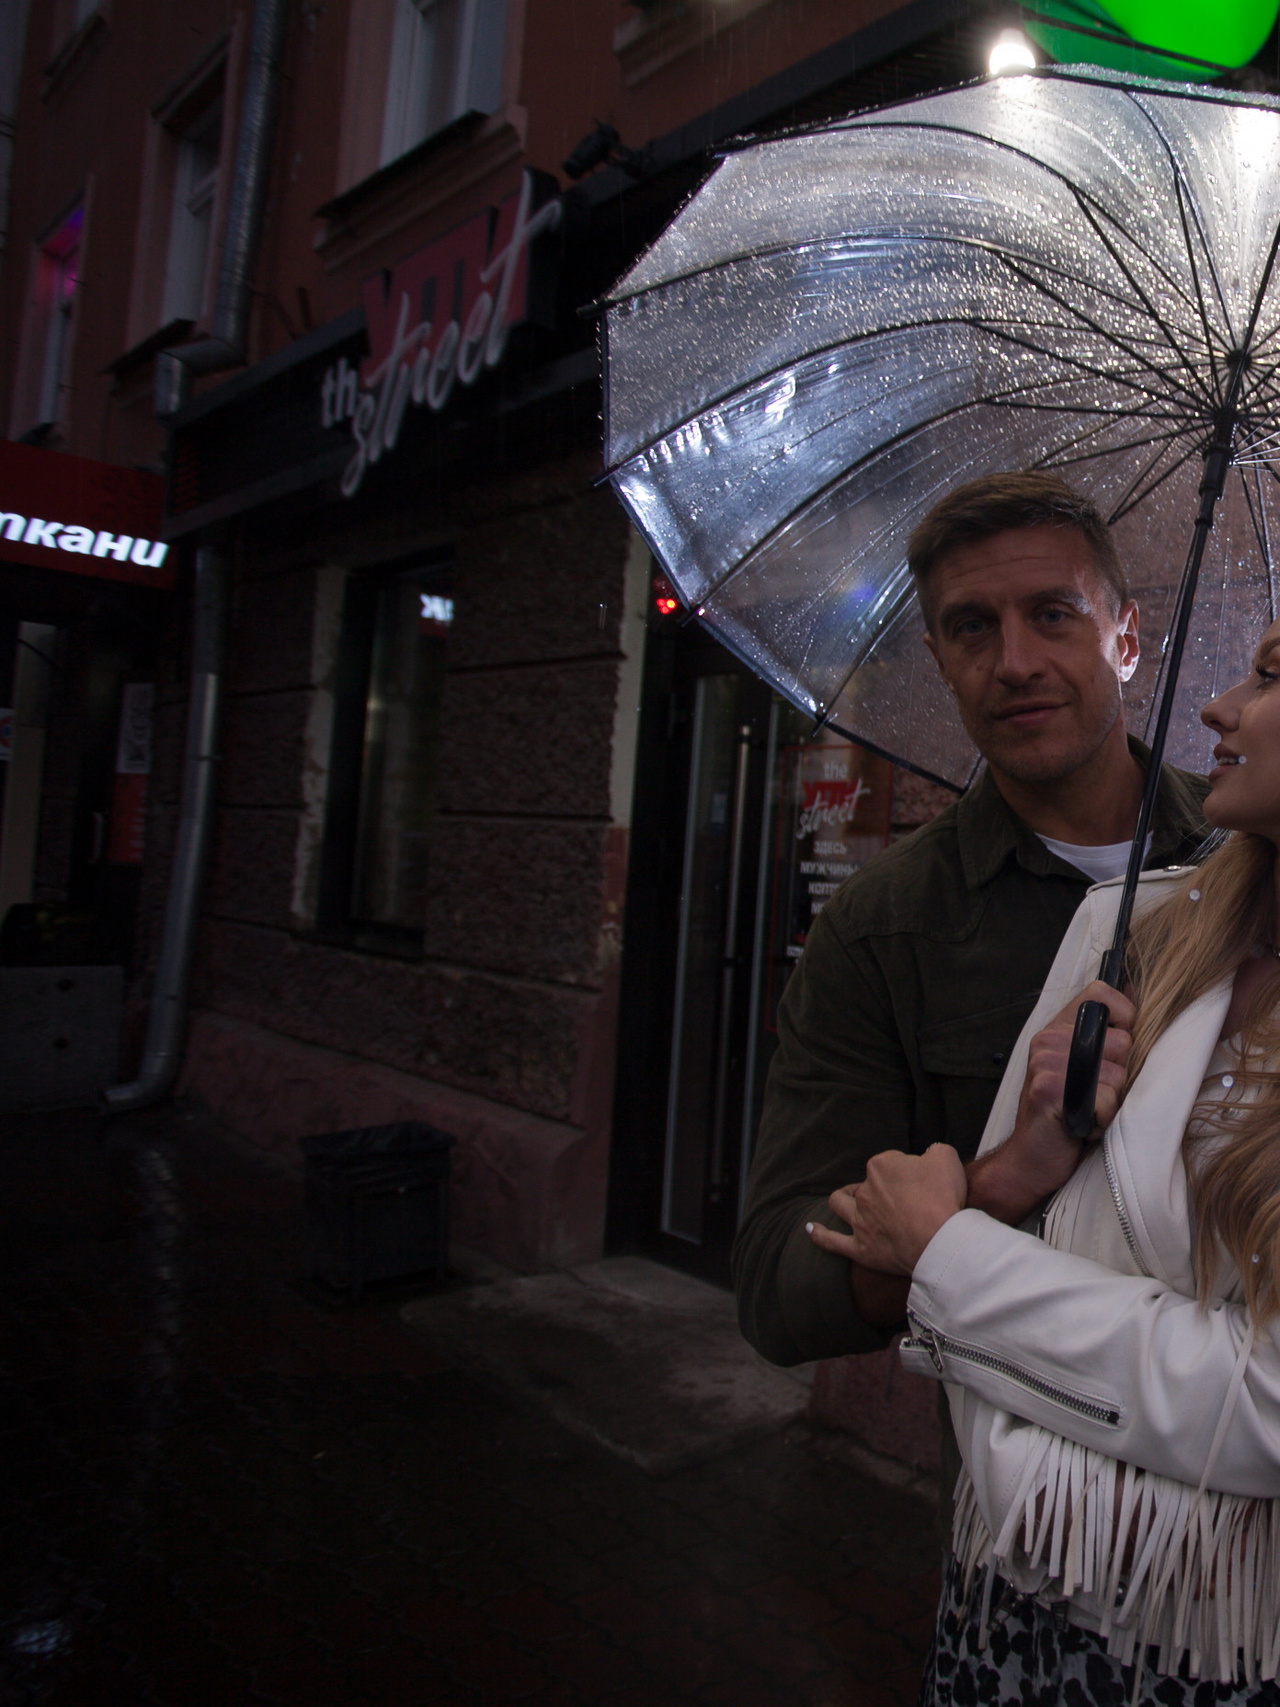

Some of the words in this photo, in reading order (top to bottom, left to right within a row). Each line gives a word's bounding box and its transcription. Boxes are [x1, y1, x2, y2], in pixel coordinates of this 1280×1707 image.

[340, 168, 562, 497] street
[823, 761, 849, 779] the
[796, 777, 871, 840] street
[812, 840, 848, 855] ЗДЕСЬ
